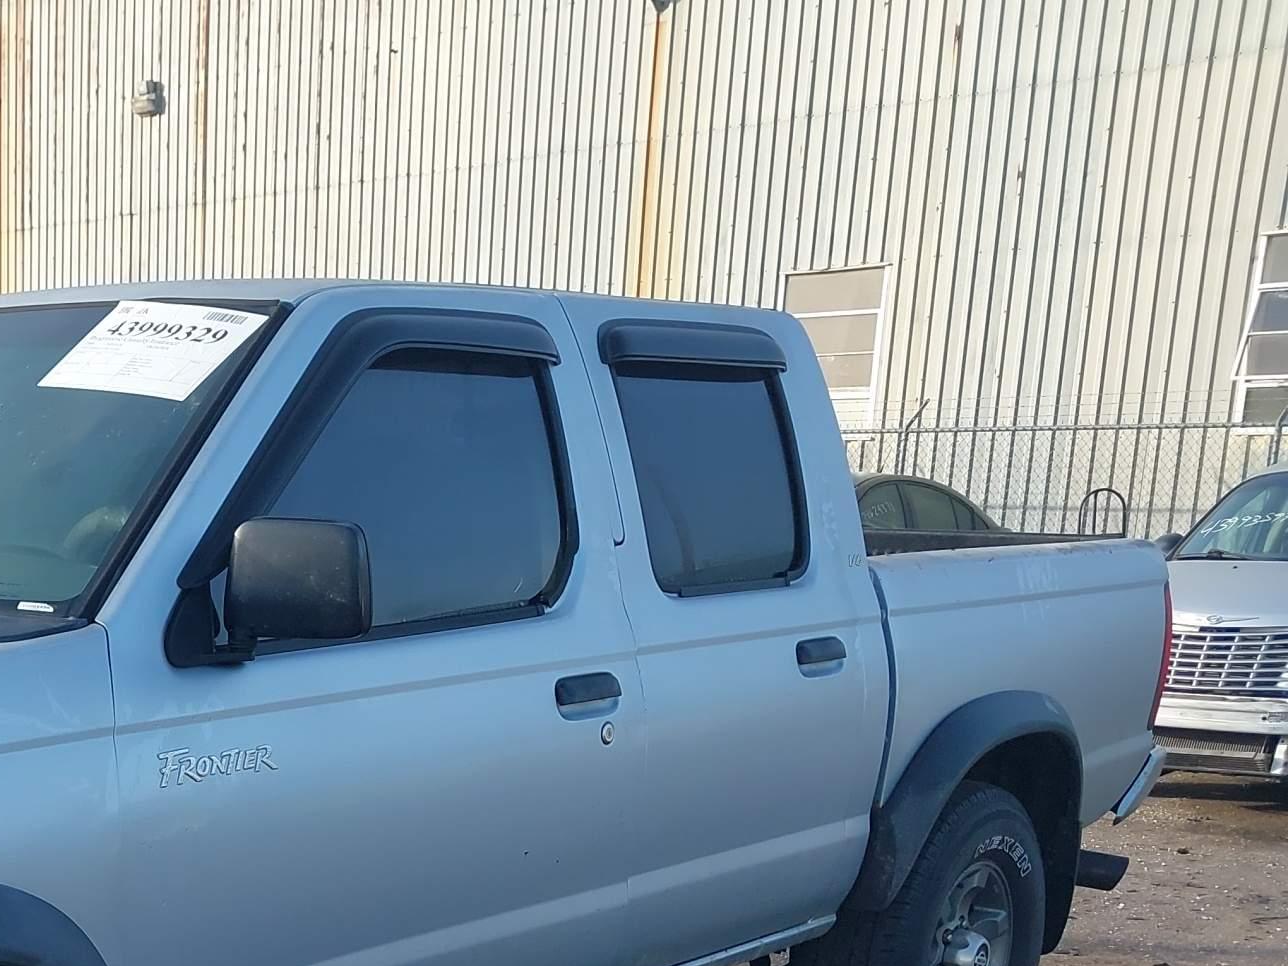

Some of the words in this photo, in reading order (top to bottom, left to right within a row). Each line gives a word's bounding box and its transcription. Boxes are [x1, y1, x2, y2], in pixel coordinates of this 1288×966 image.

[107, 320, 229, 345] 43999329
[157, 743, 280, 789] FRONTIER
[974, 835, 1032, 878] NEXEN
